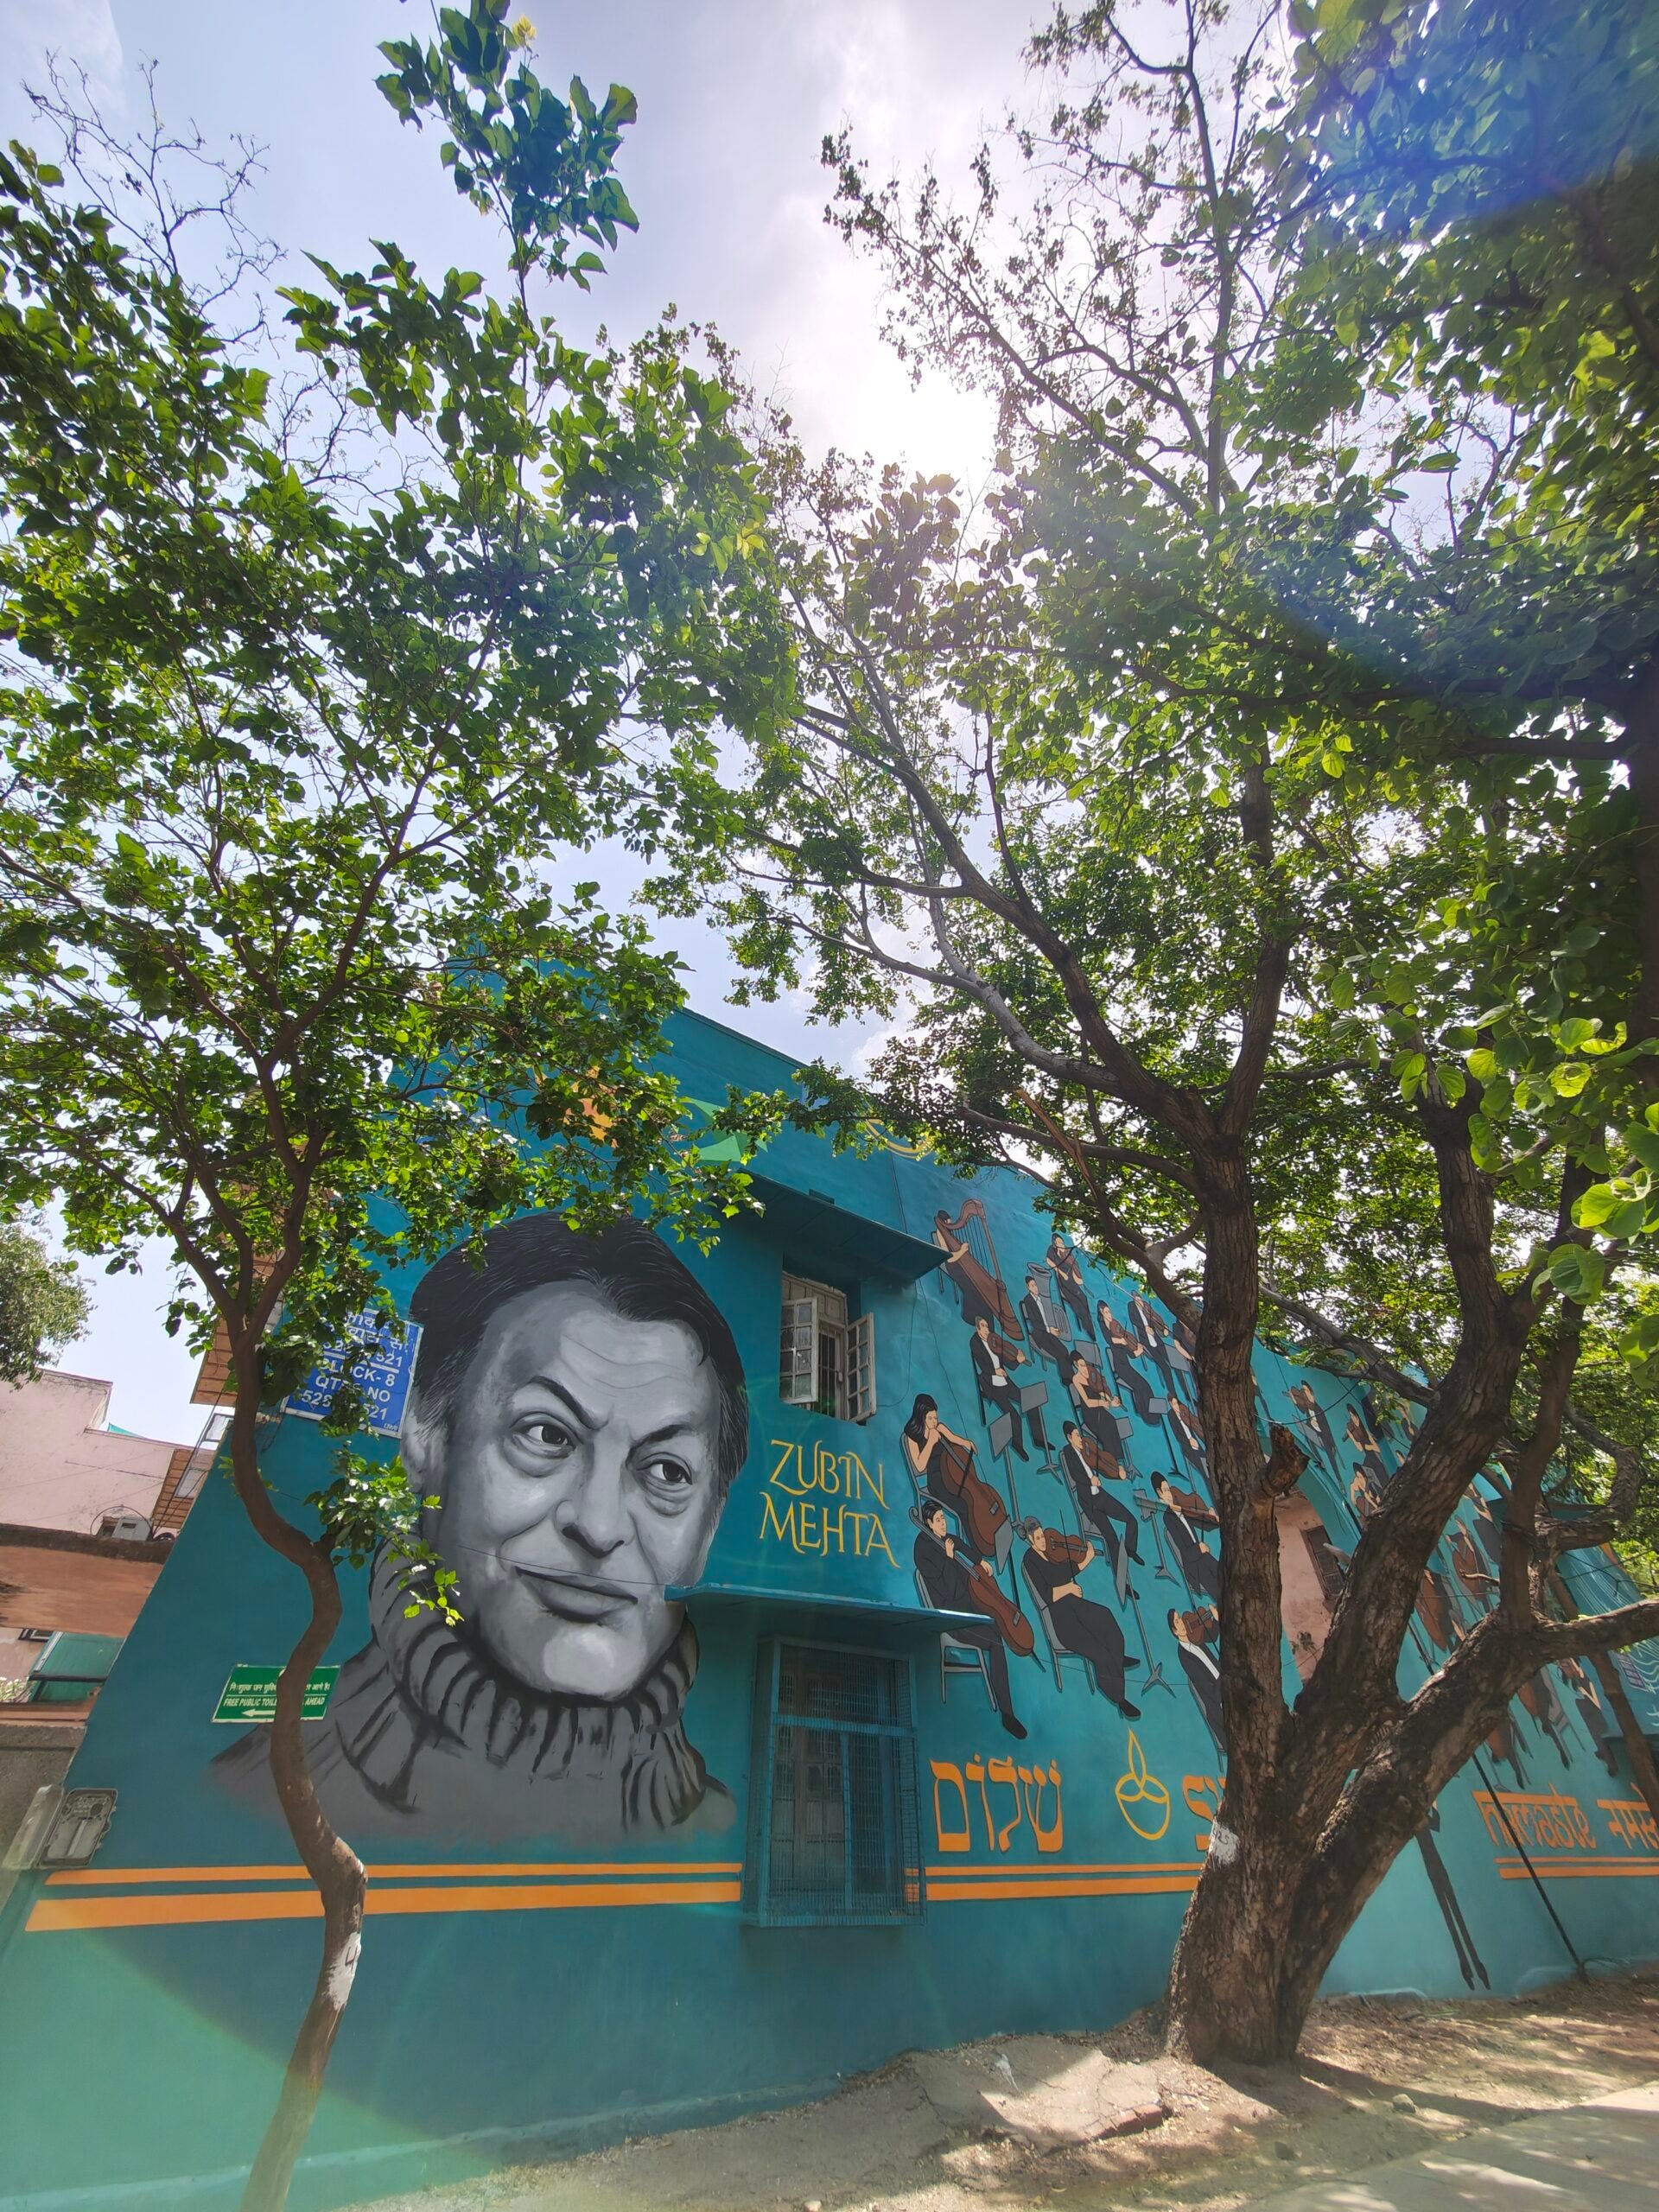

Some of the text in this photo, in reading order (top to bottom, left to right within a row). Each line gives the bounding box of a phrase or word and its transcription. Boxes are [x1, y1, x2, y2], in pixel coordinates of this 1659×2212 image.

[368, 1386, 391, 1402] NO
[769, 1439, 891, 1510] ZUBIN
[759, 1491, 901, 1568] MEHTA
[223, 1696, 325, 1707] FREE PUBLIC TOIL AHEAD
